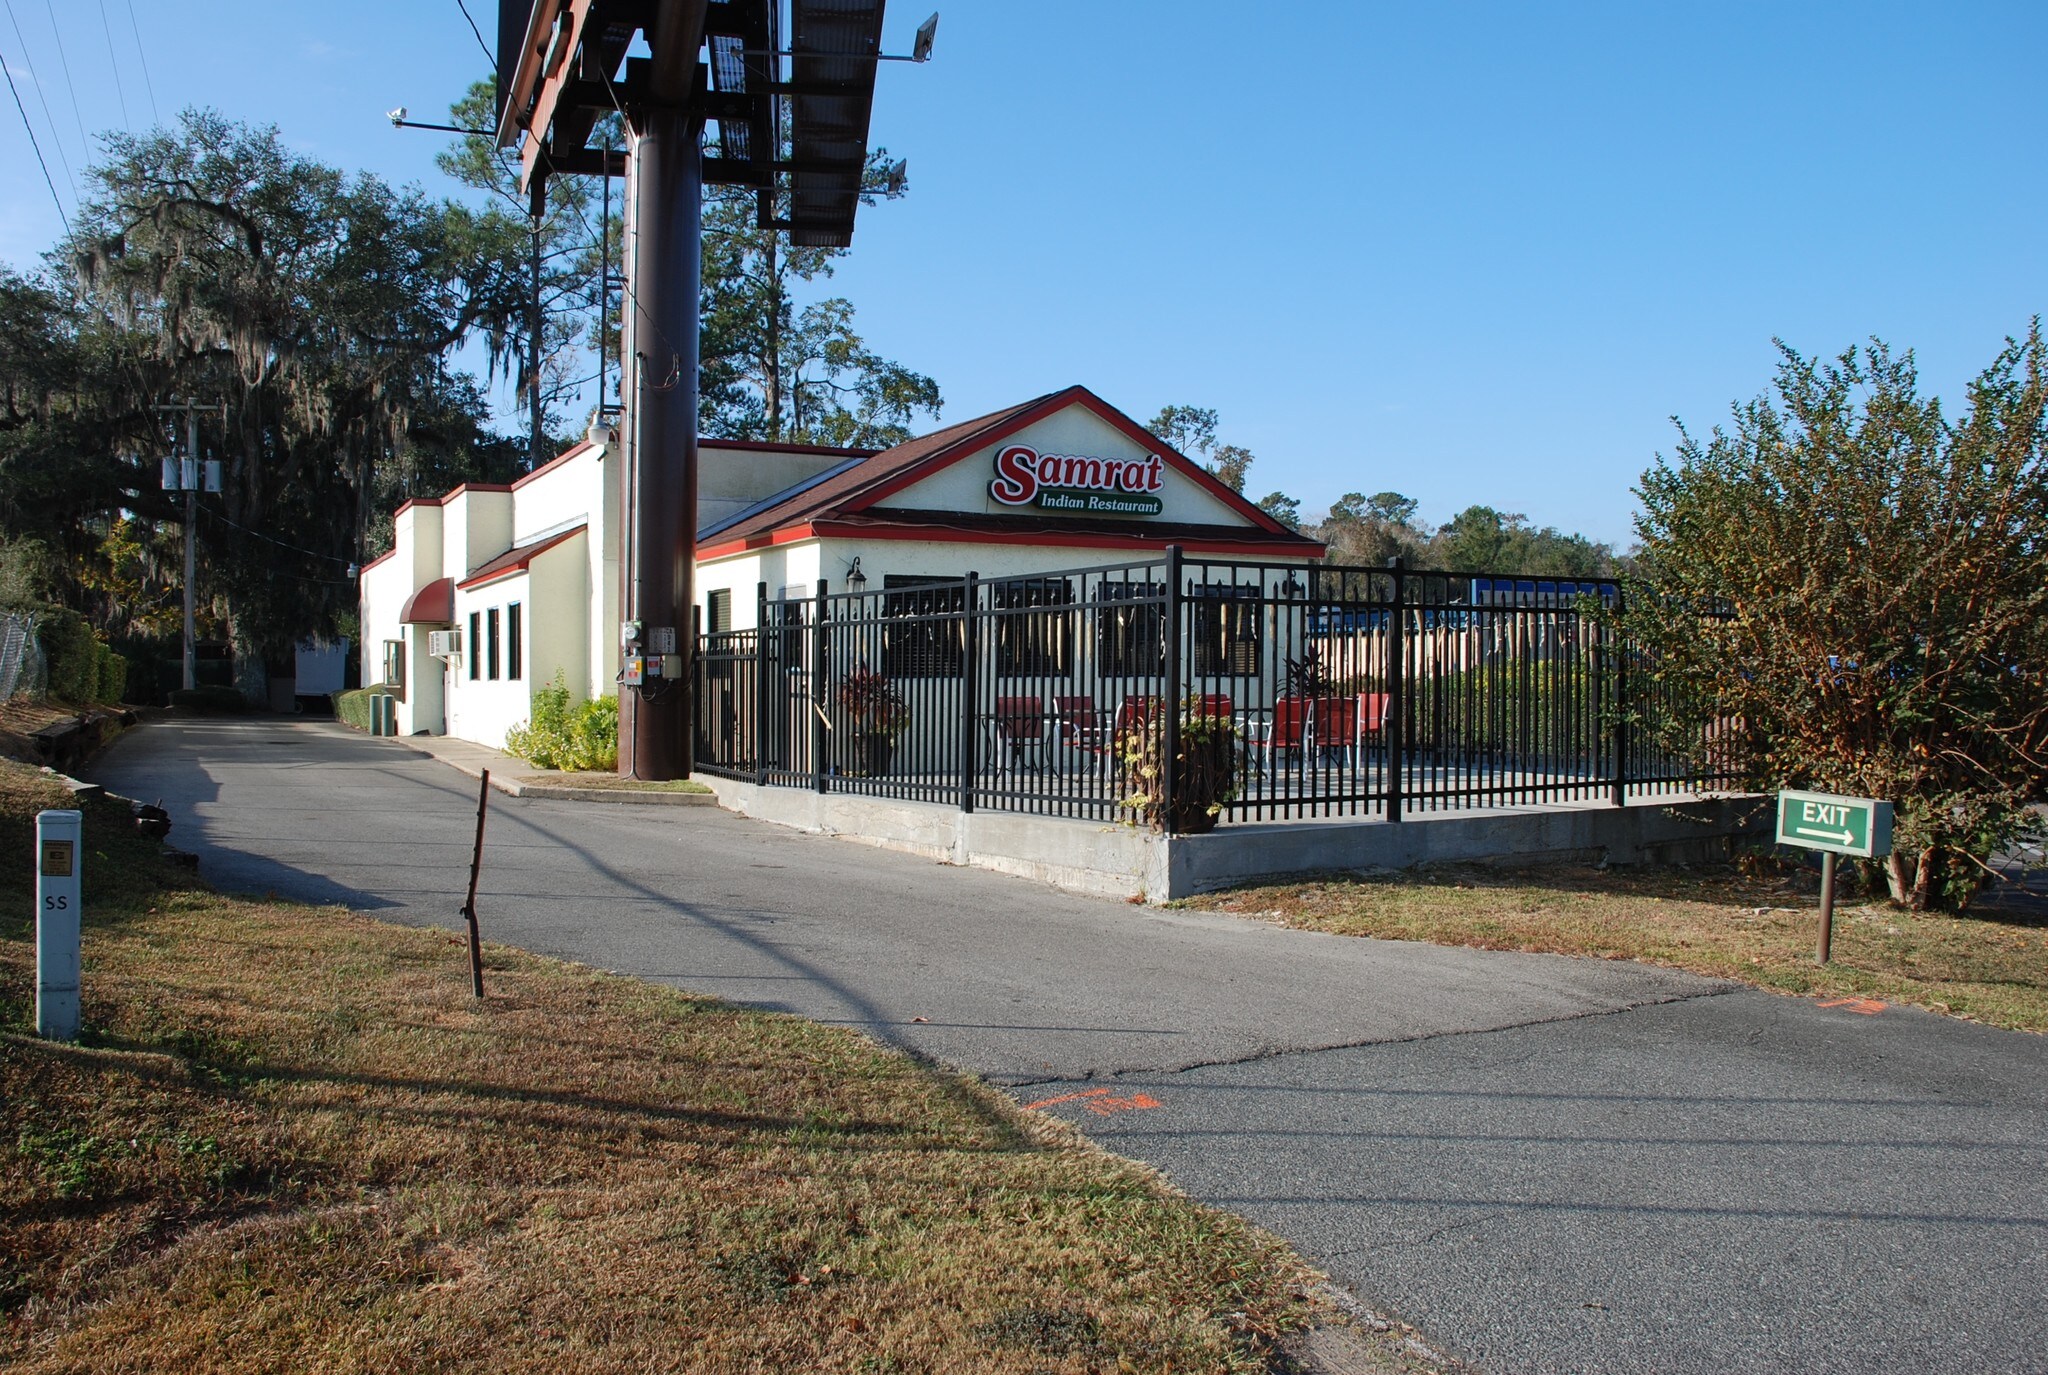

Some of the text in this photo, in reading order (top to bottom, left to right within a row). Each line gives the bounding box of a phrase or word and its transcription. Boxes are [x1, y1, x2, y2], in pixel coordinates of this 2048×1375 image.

[992, 446, 1164, 504] Samrat
[1041, 493, 1159, 513] Indian Restaurant
[1802, 802, 1850, 827] EXIT
[45, 896, 67, 910] SS
